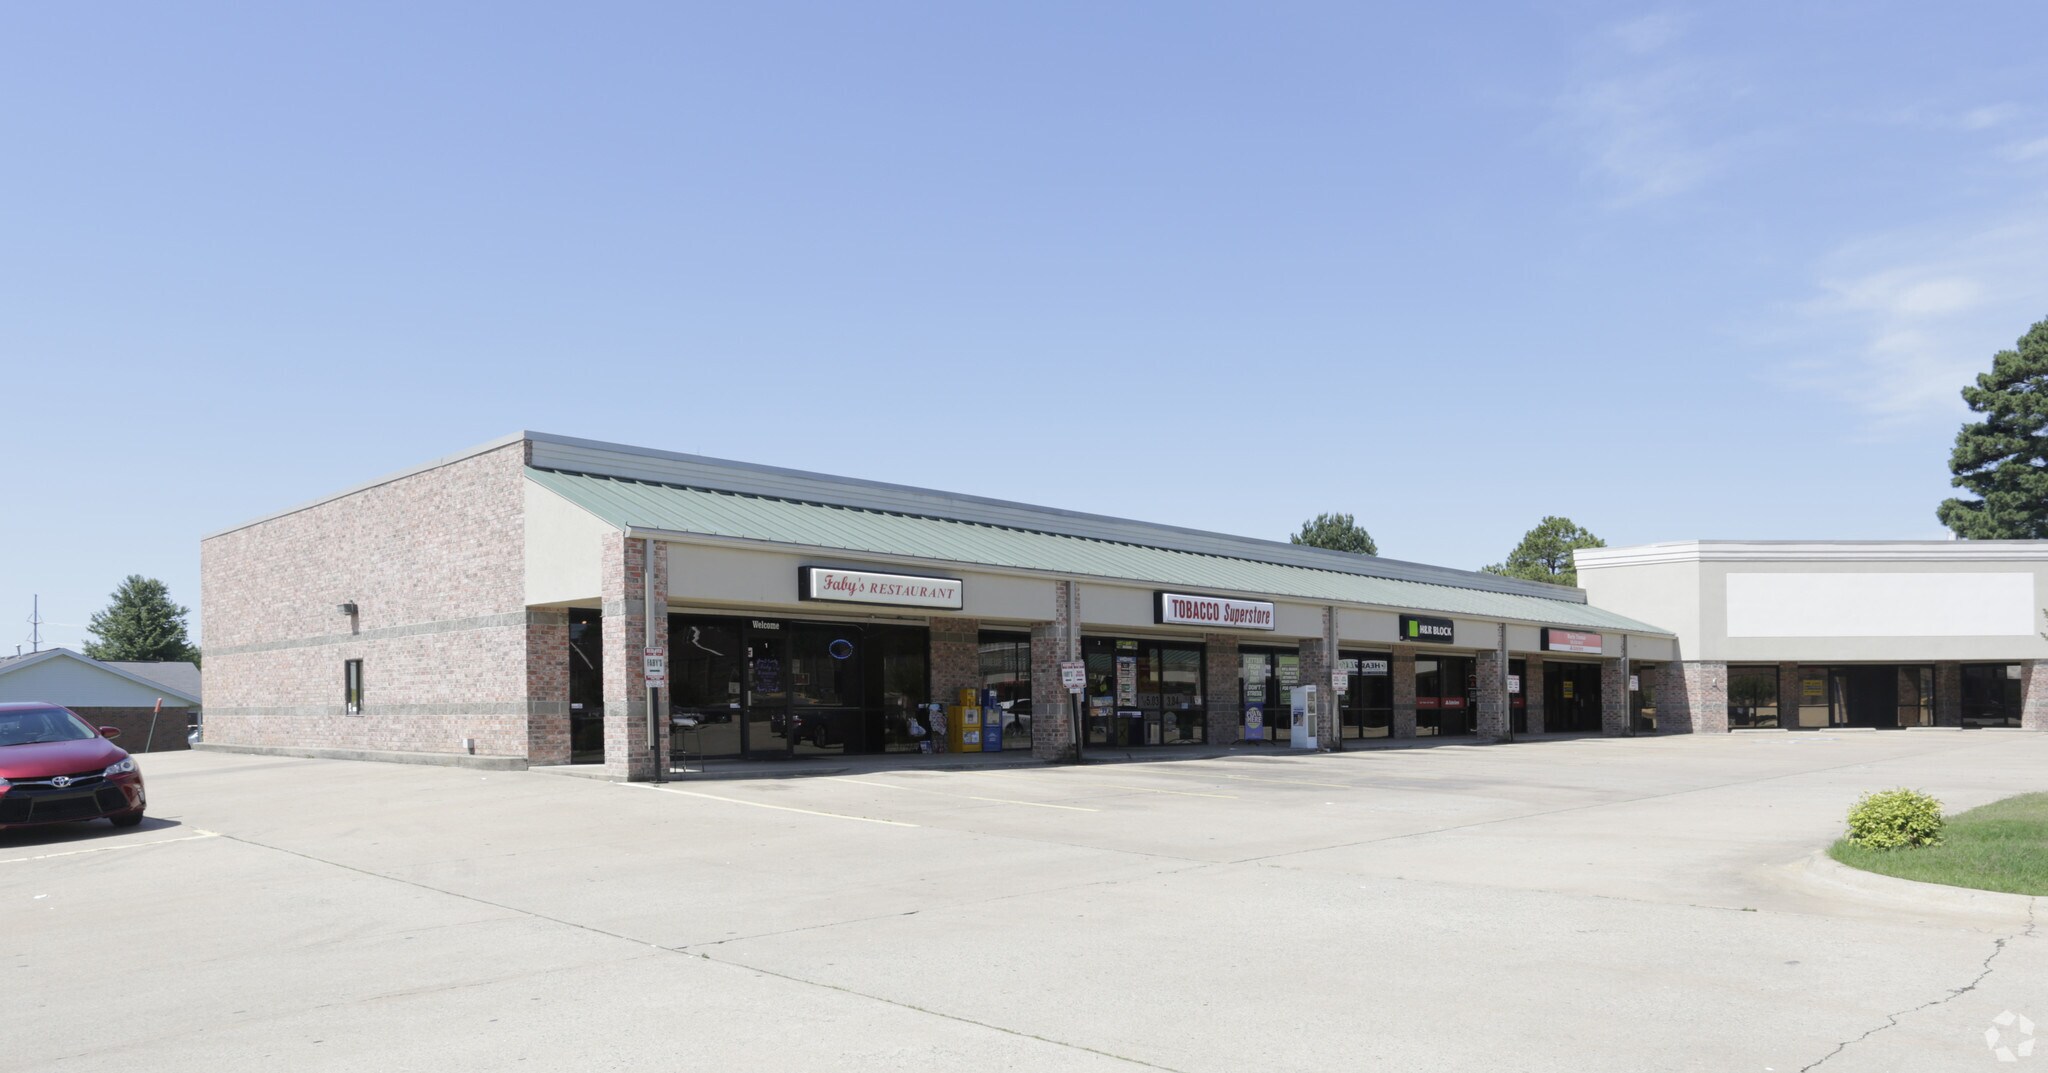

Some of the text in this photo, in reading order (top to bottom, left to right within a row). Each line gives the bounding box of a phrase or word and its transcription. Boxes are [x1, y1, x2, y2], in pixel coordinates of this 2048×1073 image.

[823, 574, 955, 599] Faby's RESTAURANT
[1172, 599, 1271, 625] TOBACCO Superstore
[752, 620, 780, 630] Welcome
[1419, 624, 1452, 636] H&R BLOCK
